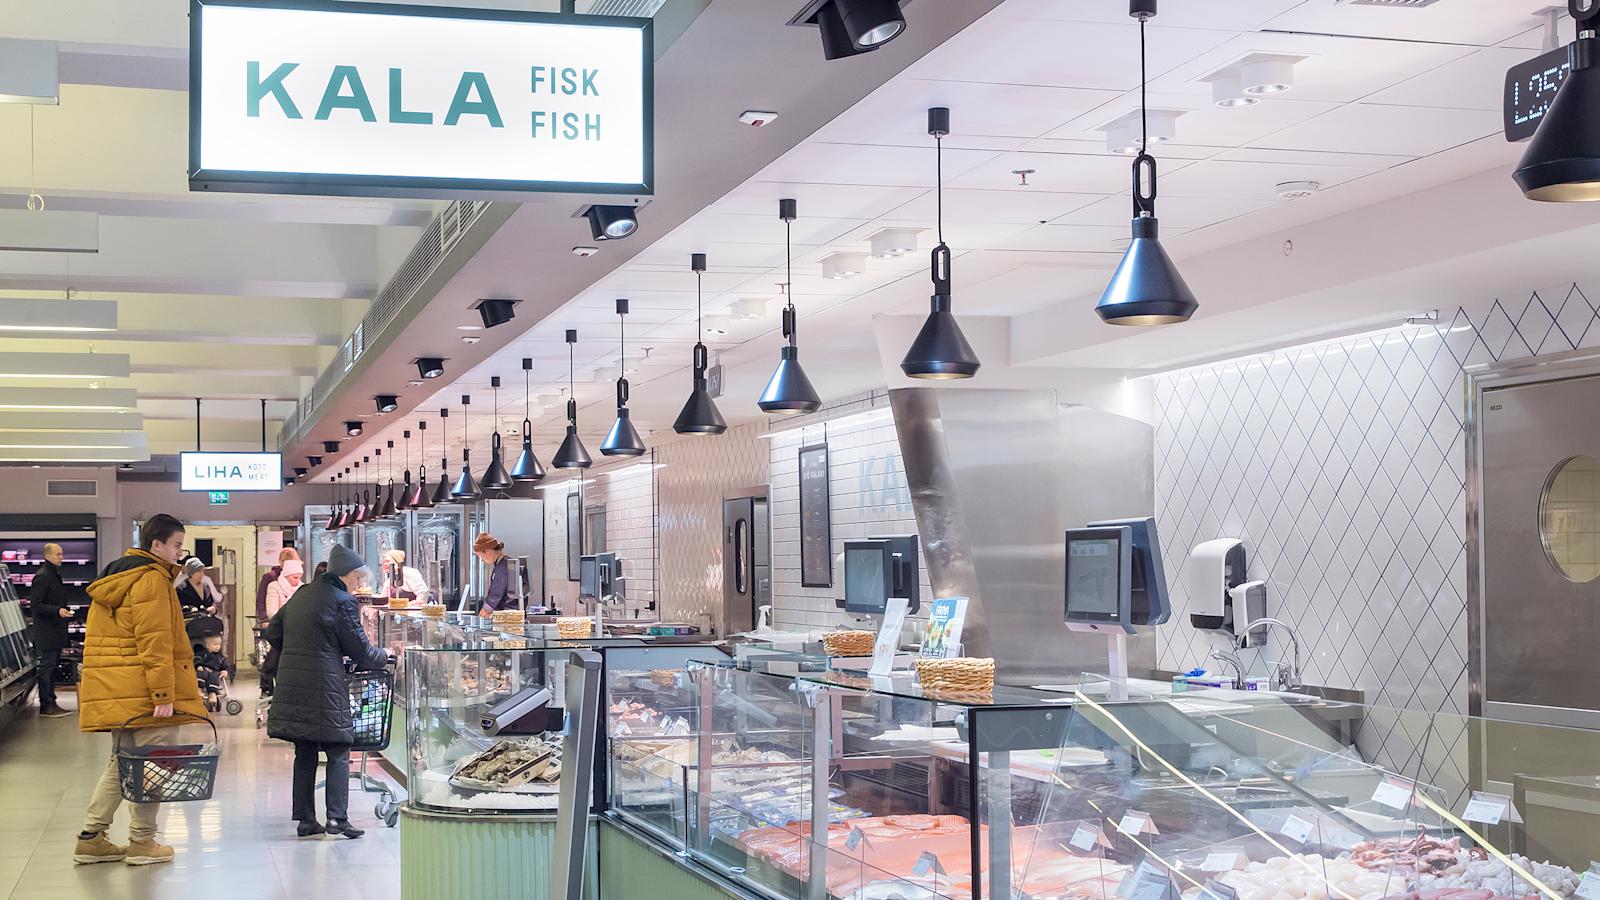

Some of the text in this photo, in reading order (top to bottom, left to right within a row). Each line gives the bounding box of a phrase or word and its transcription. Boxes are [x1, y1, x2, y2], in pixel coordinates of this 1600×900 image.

[246, 60, 504, 128] KALA
[530, 65, 600, 97] FISK
[530, 111, 601, 141] FISH
[194, 466, 243, 478] LIHA
